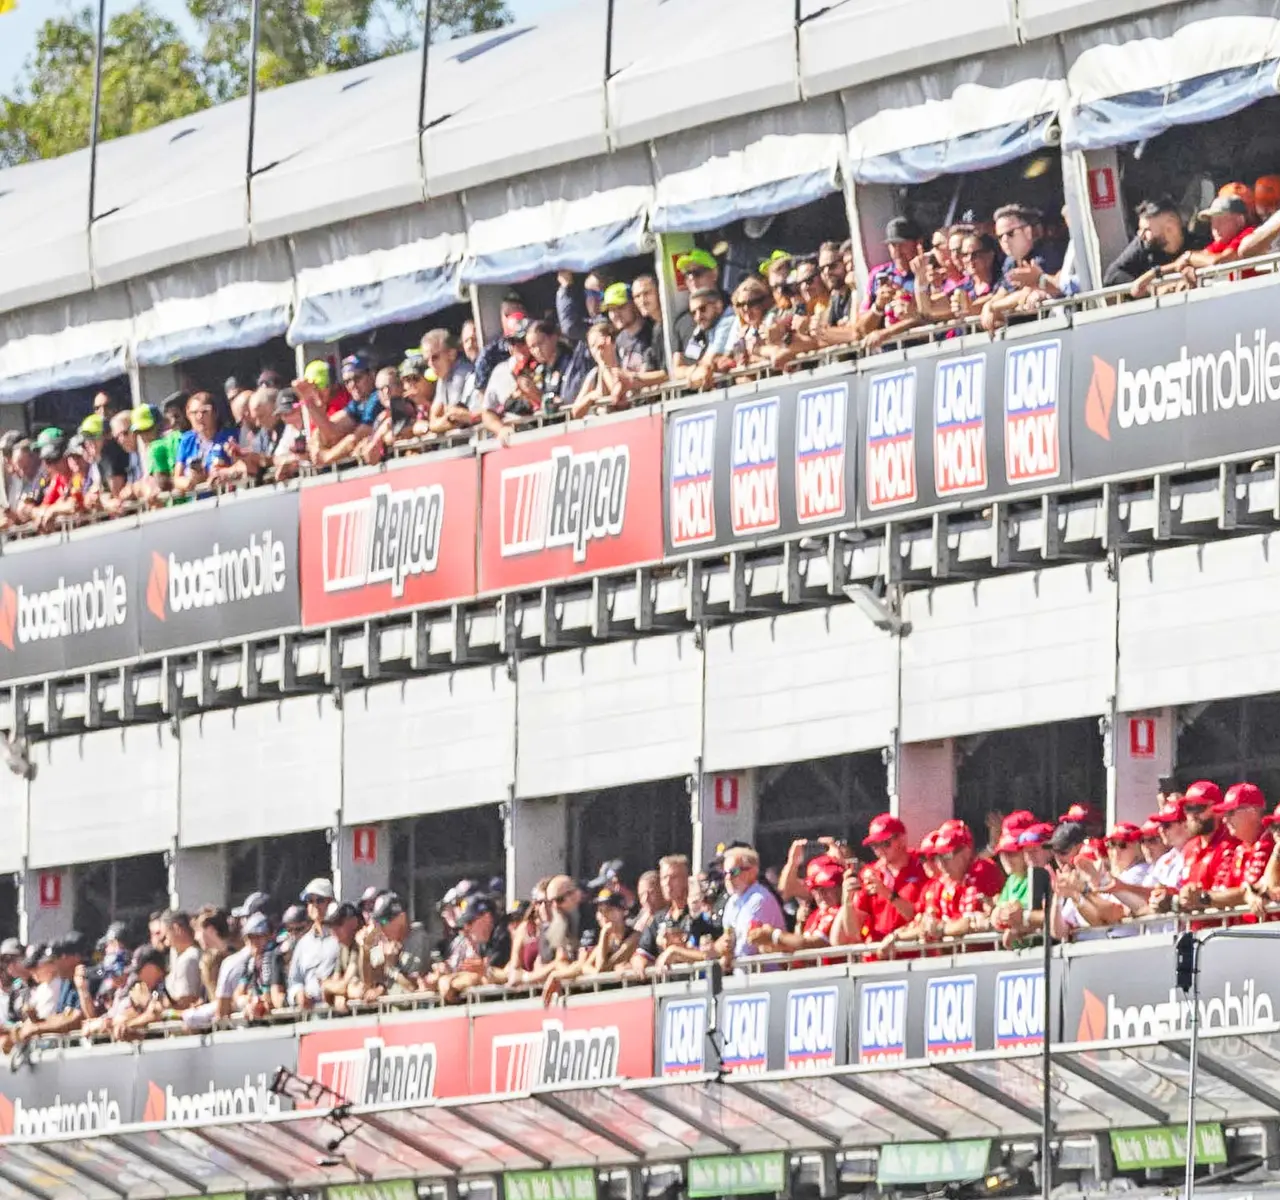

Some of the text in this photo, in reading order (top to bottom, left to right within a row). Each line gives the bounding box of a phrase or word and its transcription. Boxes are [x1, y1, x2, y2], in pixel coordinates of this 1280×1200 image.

[869, 373, 914, 438] LIQUI
[936, 358, 984, 426] LIQUI
[1007, 343, 1058, 410] LIQUI
[673, 417, 714, 480] LIQUI
[733, 403, 777, 468] LIQUI
[798, 387, 846, 453] LIQUI
[1007, 414, 1056, 482] MOLY
[799, 456, 844, 519] MOLY
[869, 439, 915, 507] MOLY
[936, 426, 985, 494] MOLY
[548, 446, 628, 562] Repco
[673, 481, 713, 546] MOLY
[733, 468, 778, 532] MOLY
[168, 530, 287, 612] boostmobile
[368, 484, 444, 598] Repco
[17, 566, 127, 643] boostmobile
[665, 1003, 706, 1067] LIQUI
[788, 992, 836, 1056] LIQUI
[861, 987, 906, 1052] LIQUI
[928, 980, 975, 1047] LIQUI
